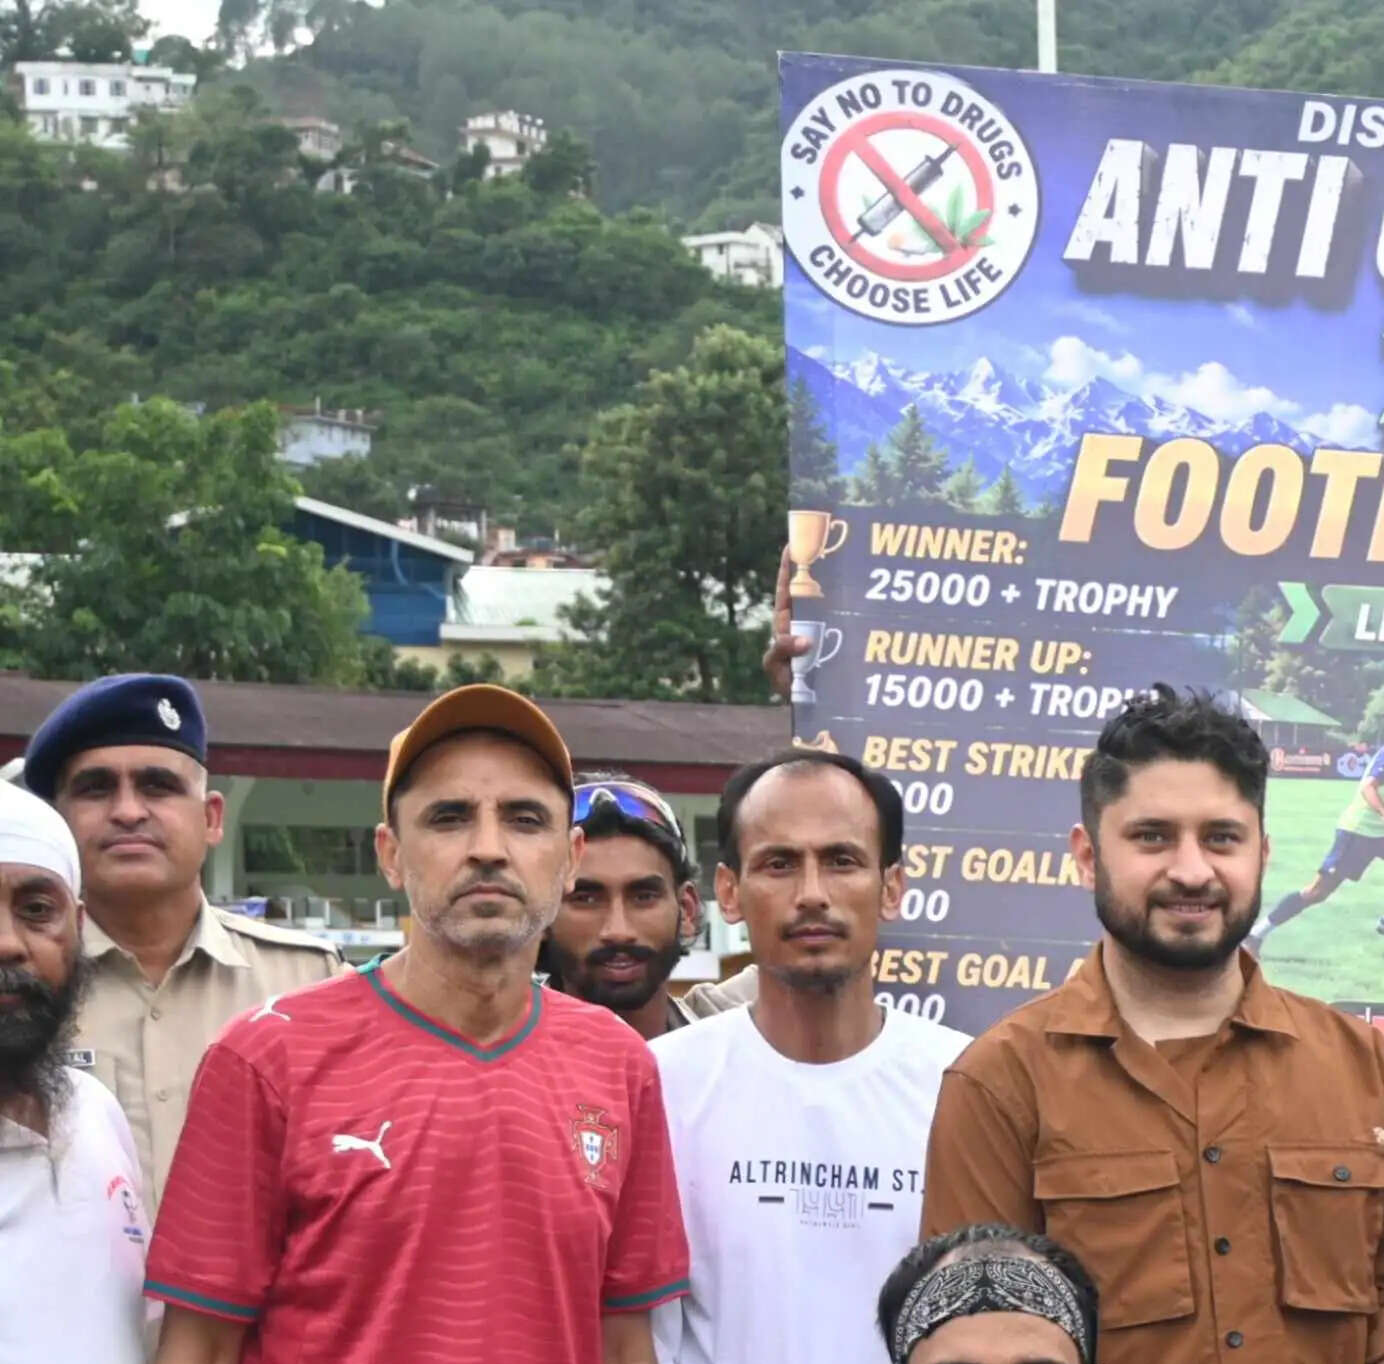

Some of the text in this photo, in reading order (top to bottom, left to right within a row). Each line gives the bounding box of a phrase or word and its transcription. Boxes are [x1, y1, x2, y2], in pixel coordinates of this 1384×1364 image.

[789, 80, 1023, 182] SAY NO TO DRUGS
[1062, 138, 1352, 279] ANTI
[808, 242, 1003, 315] CHOOSE LIFE
[870, 522, 1027, 565] WINNER:
[865, 569, 1177, 619] 25000 + TROPHY
[864, 630, 1092, 675] RUNNER UP:
[864, 674, 983, 711] 15000
[995, 688, 1015, 708] +
[863, 736, 1097, 780] BEST STRIKE
[891, 780, 954, 815] 00
[902, 844, 1081, 886] ST GOALK
[957, 953, 1051, 990] GOAL
[729, 1160, 925, 1195] ALTRINCHAM ST.
